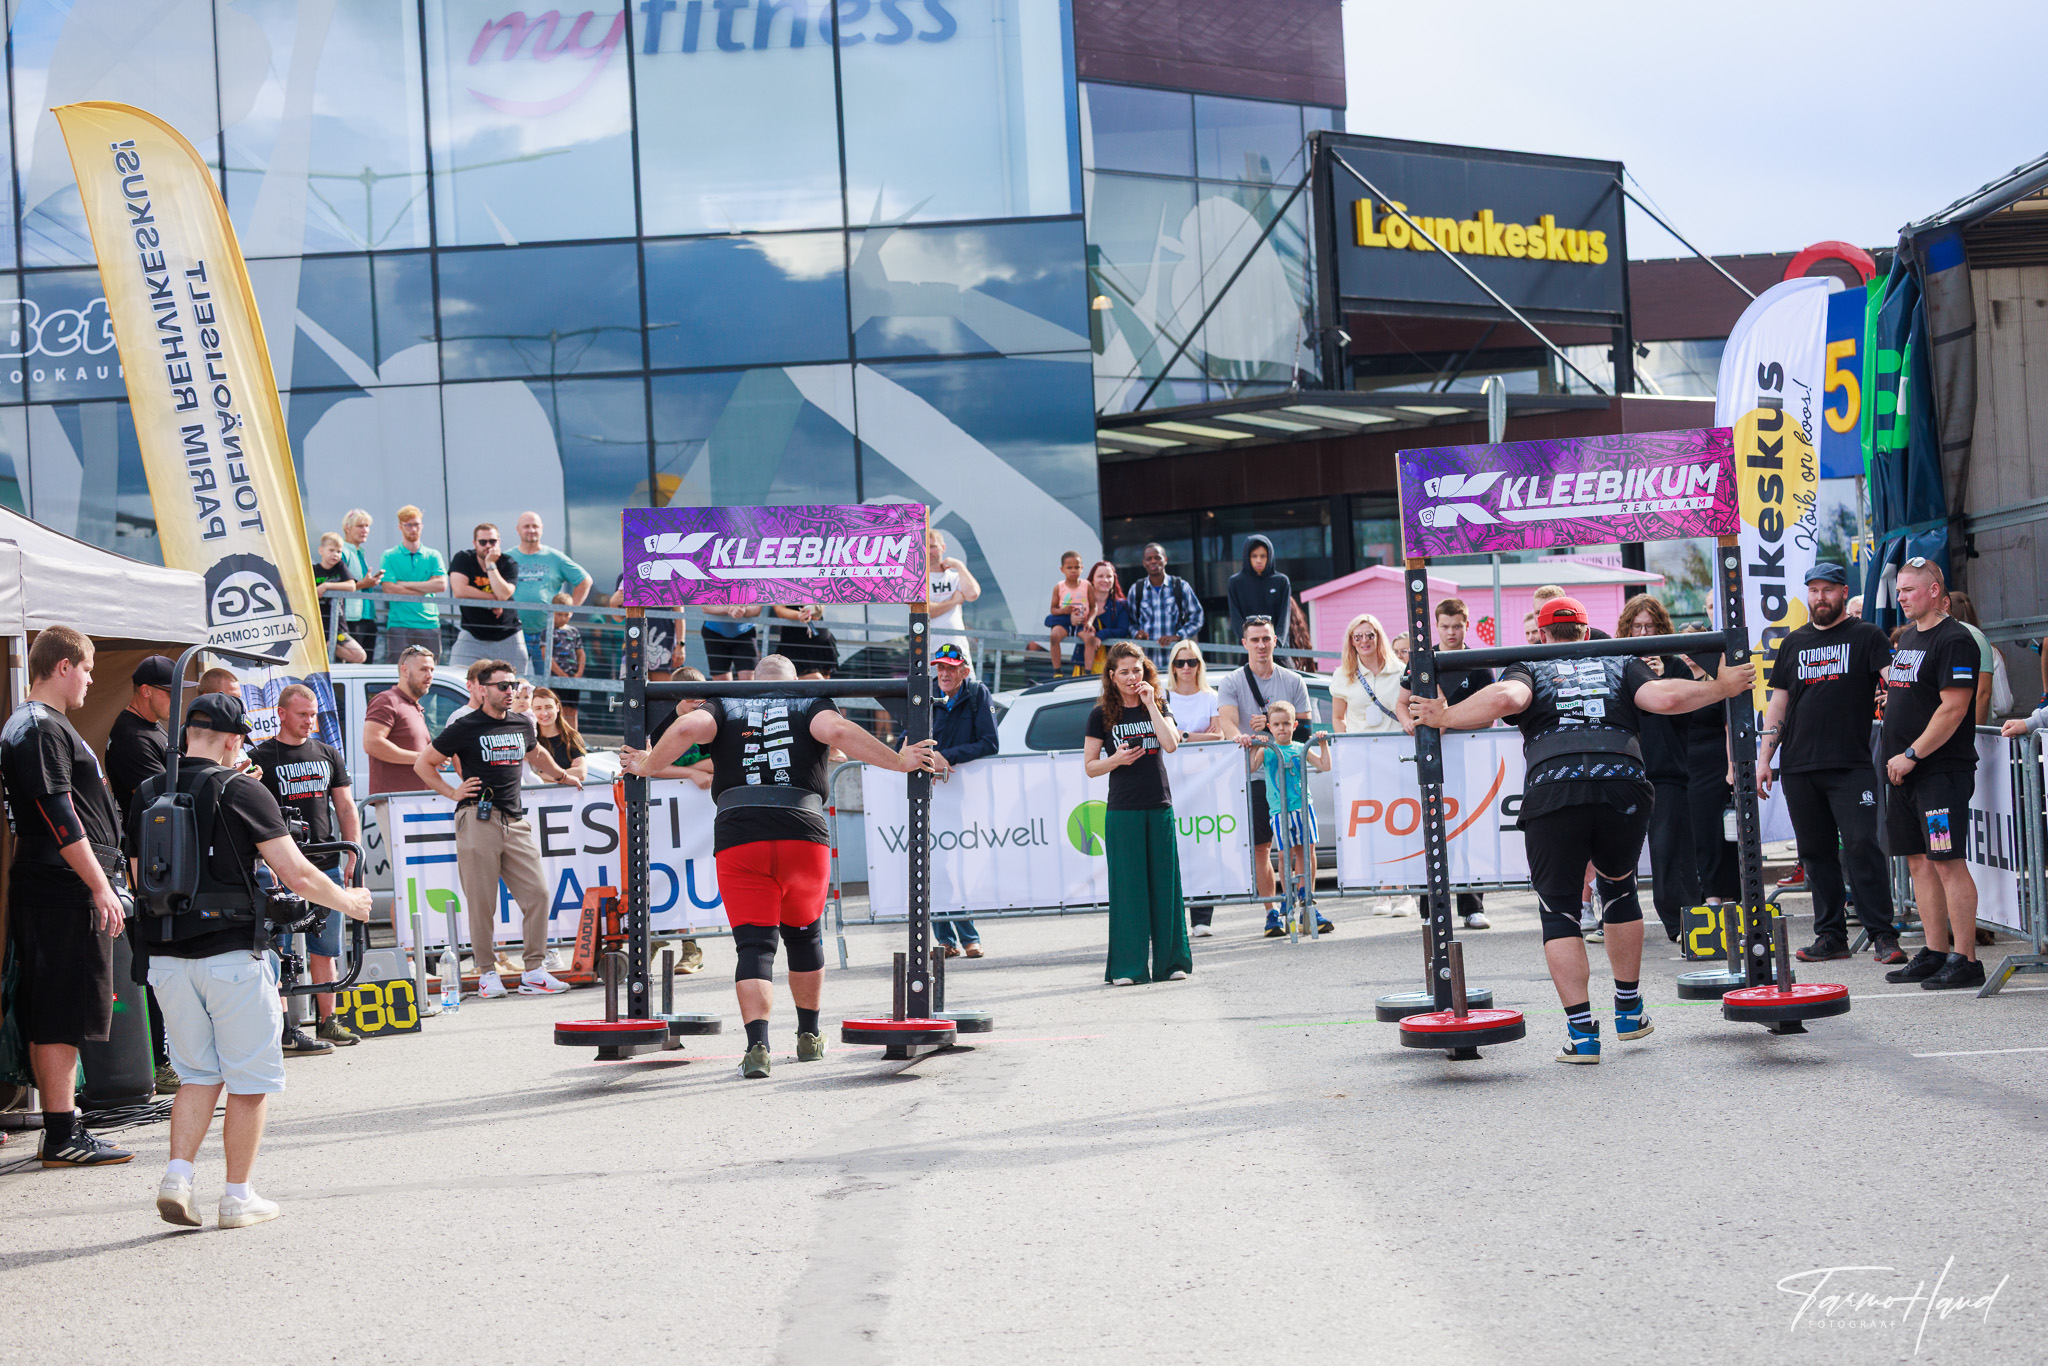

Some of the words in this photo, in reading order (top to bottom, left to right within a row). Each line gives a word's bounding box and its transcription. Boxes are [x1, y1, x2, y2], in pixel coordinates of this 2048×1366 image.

[1355, 197, 1609, 266] Lõunakeskus
[0, 365, 125, 384] OOKAU
[1824, 338, 1862, 434] 5
[1791, 378, 1814, 447] koos!
[1499, 463, 1721, 508] KLEEBIKUM
[1799, 453, 1816, 482] on
[1620, 498, 1707, 513] REKLAAM
[1792, 490, 1818, 551] Kõik
[710, 535, 912, 566] KLEEBIKUM
[818, 567, 898, 577] REKLAAM
[288, 792, 313, 800] ESTONIA
[522, 797, 681, 858] ESI
[1175, 814, 1237, 844] upp
[580, 908, 596, 958] LAADUR
